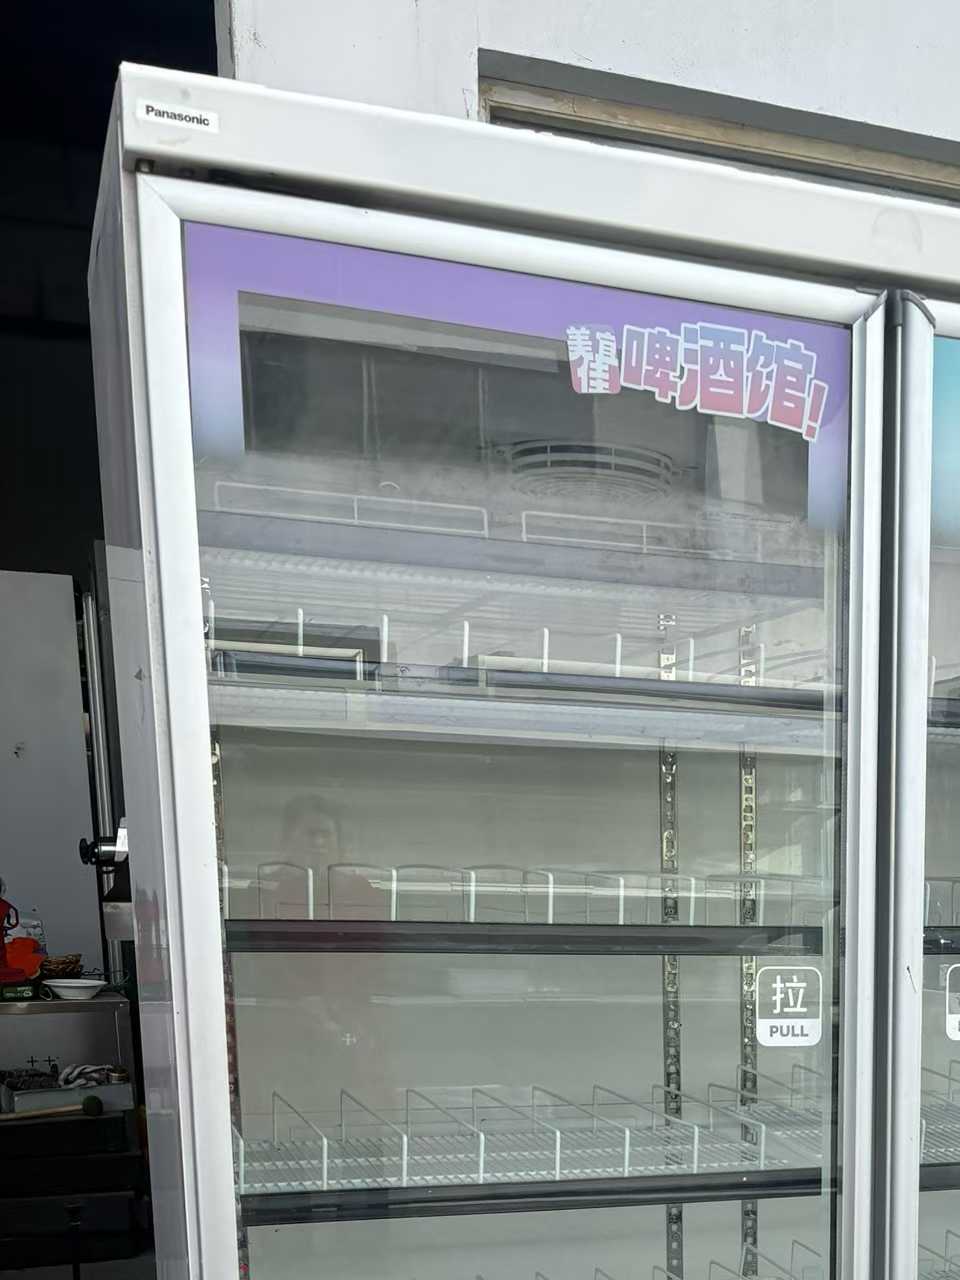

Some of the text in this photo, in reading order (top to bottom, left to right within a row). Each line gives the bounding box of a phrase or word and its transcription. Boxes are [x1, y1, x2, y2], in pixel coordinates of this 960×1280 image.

[145, 104, 210, 127] Panasonic
[772, 975, 808, 1014] 拉
[769, 1025, 809, 1037] PULL
